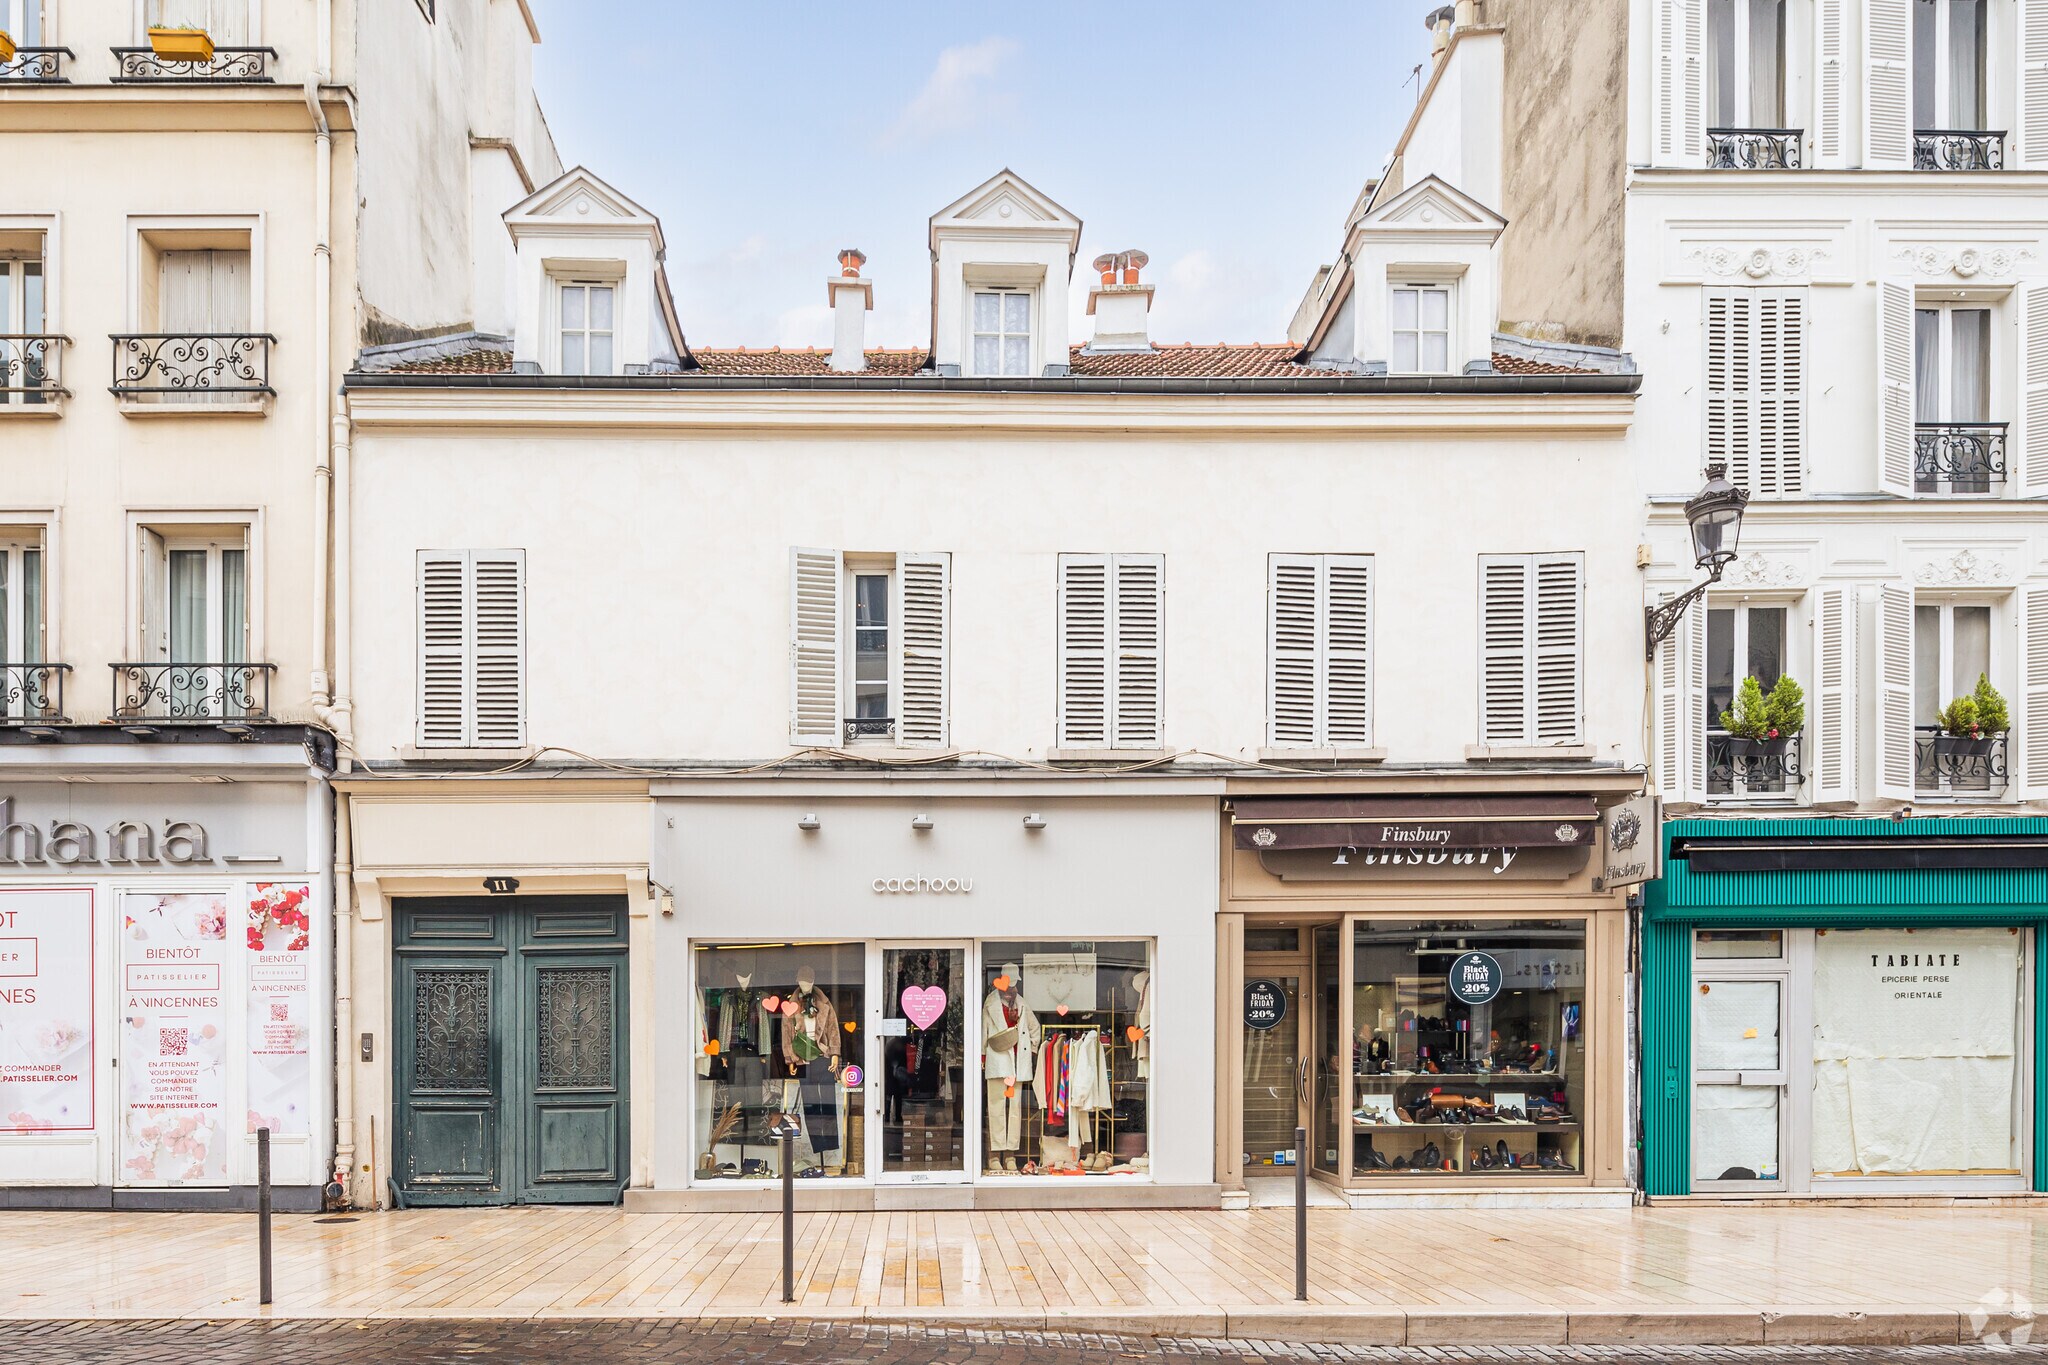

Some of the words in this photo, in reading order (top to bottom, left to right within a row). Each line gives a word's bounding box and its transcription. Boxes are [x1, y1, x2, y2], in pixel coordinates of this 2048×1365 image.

[1381, 826, 1451, 845] Finsbury
[494, 880, 508, 891] 11
[872, 873, 973, 892] cachoou
[146, 945, 201, 959] BIENTÔT
[259, 953, 298, 963] BIENTÔT
[1871, 954, 1960, 967] TABIATE
[1463, 965, 1489, 973] Black
[1463, 972, 1489, 980] FRIDAY
[1461, 983, 1490, 993] -20%
[129, 995, 138, 1007] À
[141, 997, 218, 1008] VINCENNES
[1249, 1010, 1275, 1018] -20%
